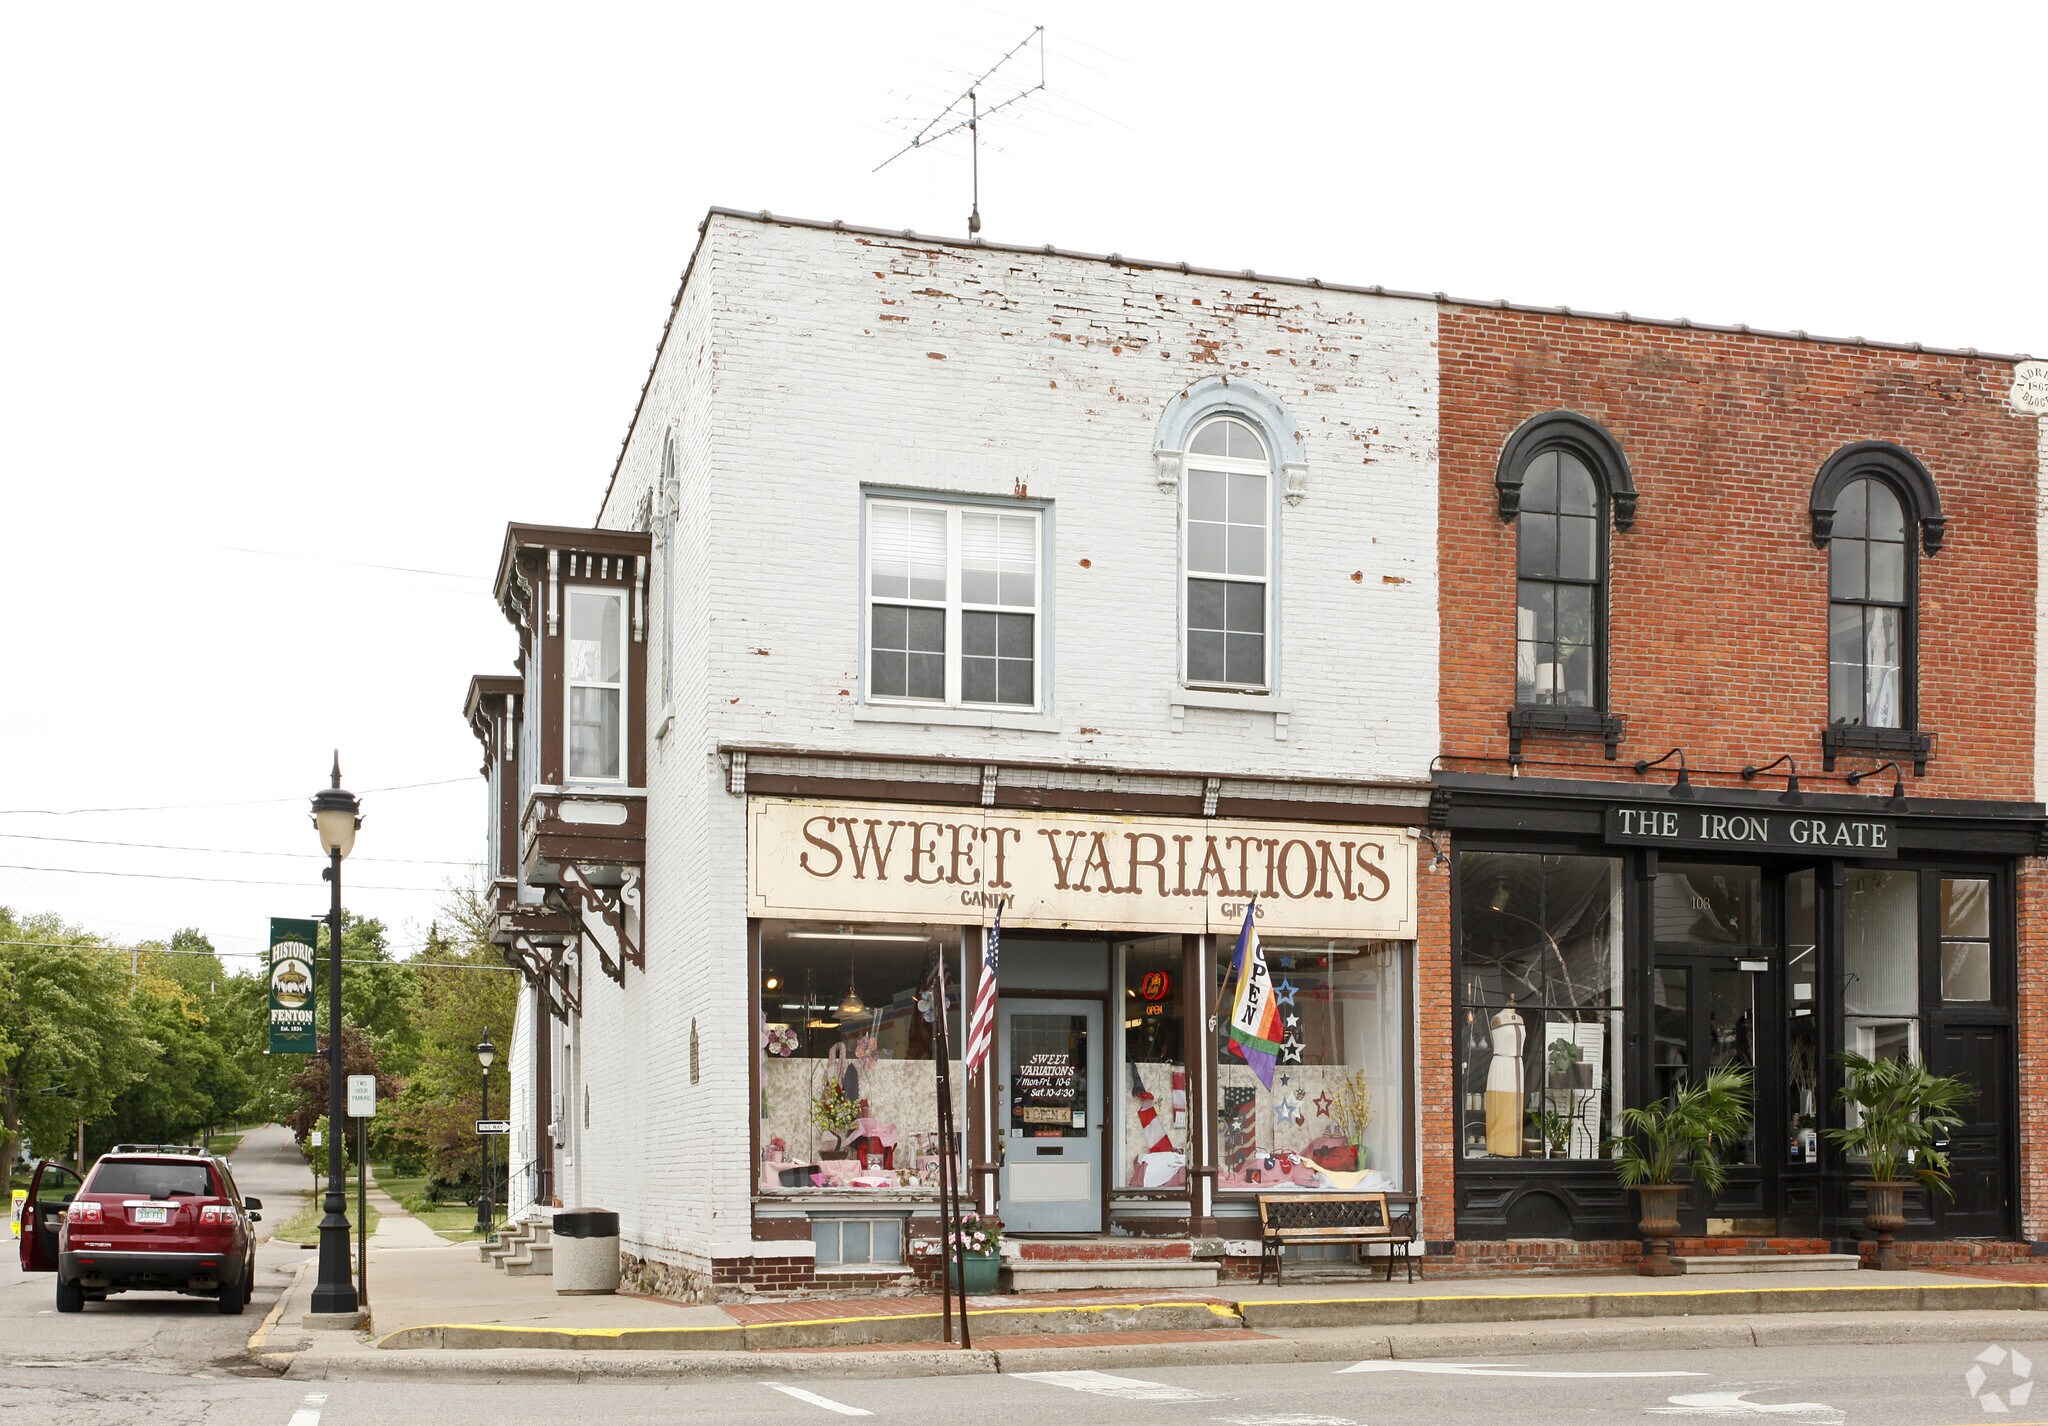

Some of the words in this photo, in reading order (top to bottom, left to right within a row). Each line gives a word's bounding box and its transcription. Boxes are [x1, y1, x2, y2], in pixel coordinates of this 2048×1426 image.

[2022, 391, 2048, 407] BLOC
[1618, 809, 1679, 837] THE
[1700, 814, 1769, 841] IRON
[1789, 819, 1888, 848] GRATE
[800, 816, 1021, 889] SWEET
[1037, 828, 1390, 901] VARIATIONS
[1221, 902, 1265, 920] GIFS
[271, 941, 314, 965] HISTORIC
[271, 1009, 313, 1022] FENTON
[1146, 1005, 1163, 1015] OPEN
[1030, 1054, 1069, 1065] SWEET
[1020, 1065, 1075, 1076] VARIATIONS
